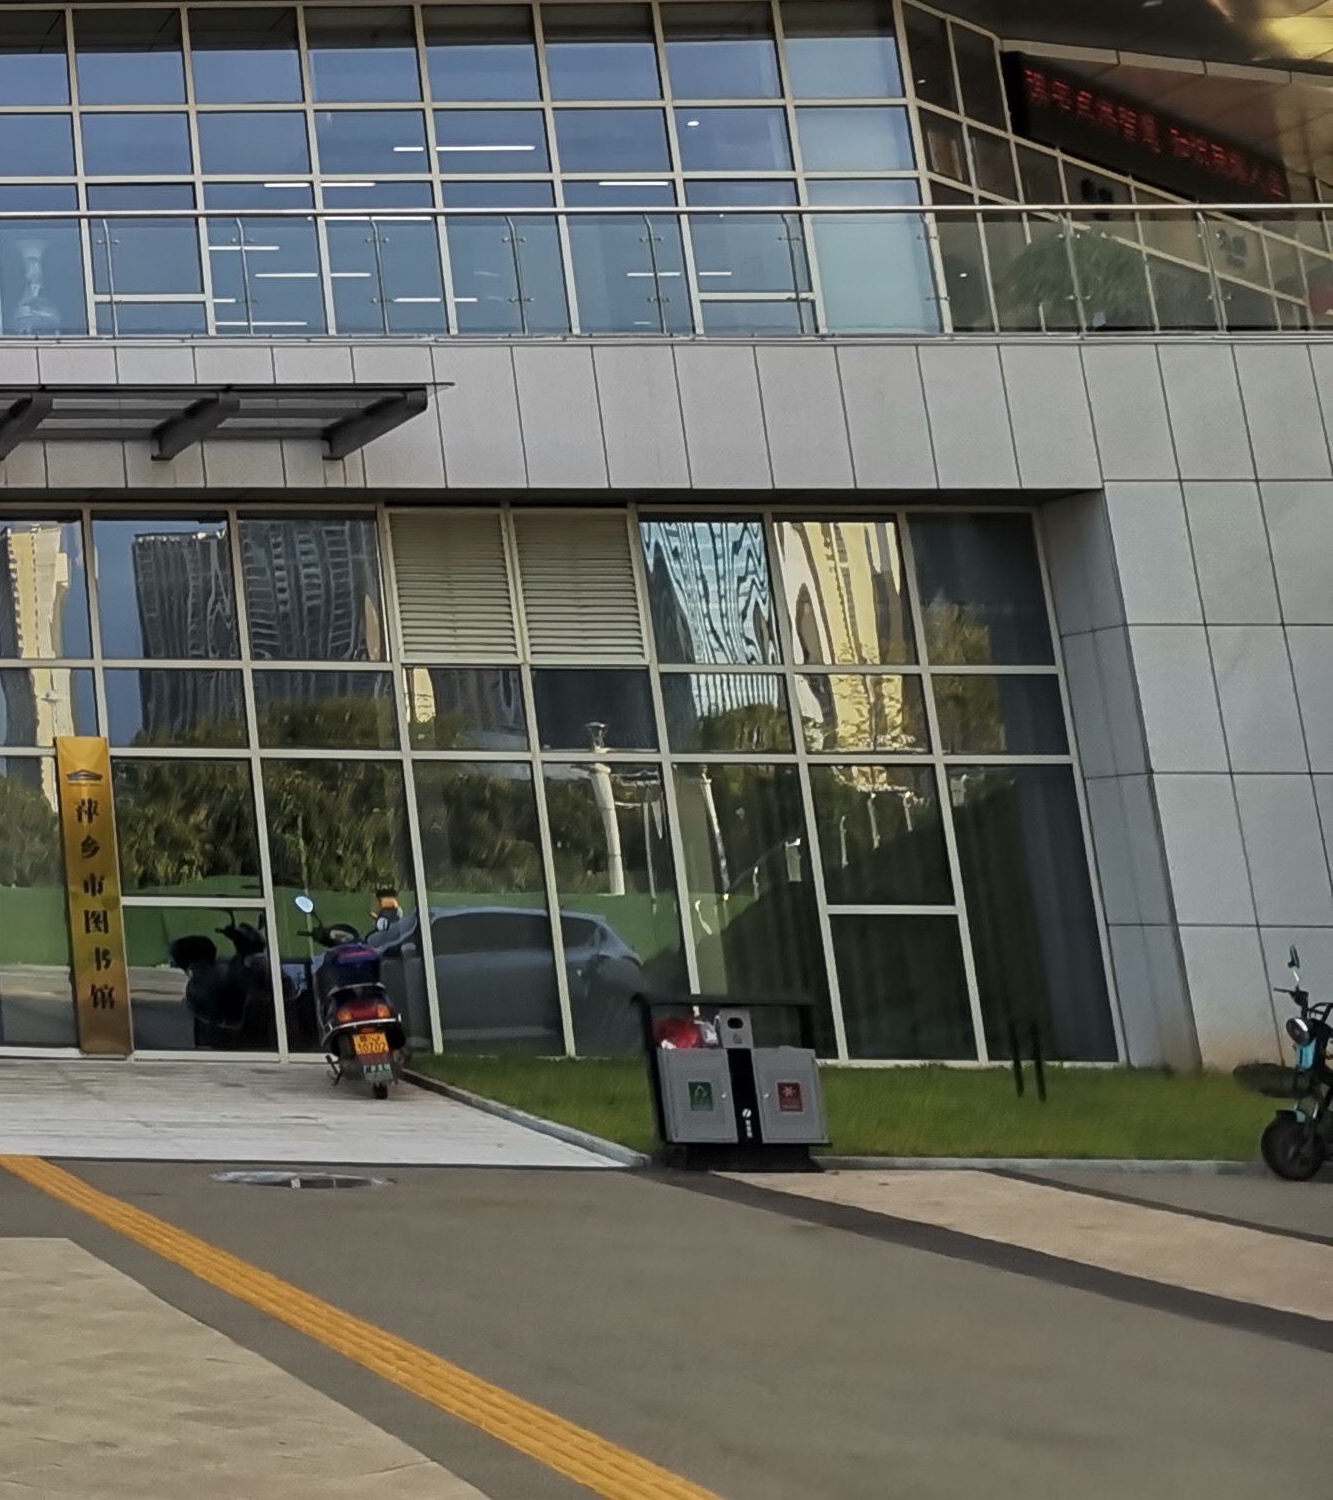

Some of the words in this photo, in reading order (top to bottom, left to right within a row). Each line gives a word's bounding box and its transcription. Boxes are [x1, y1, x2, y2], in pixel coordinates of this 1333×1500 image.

[75, 797, 116, 1011] 萍乡市图书馆
